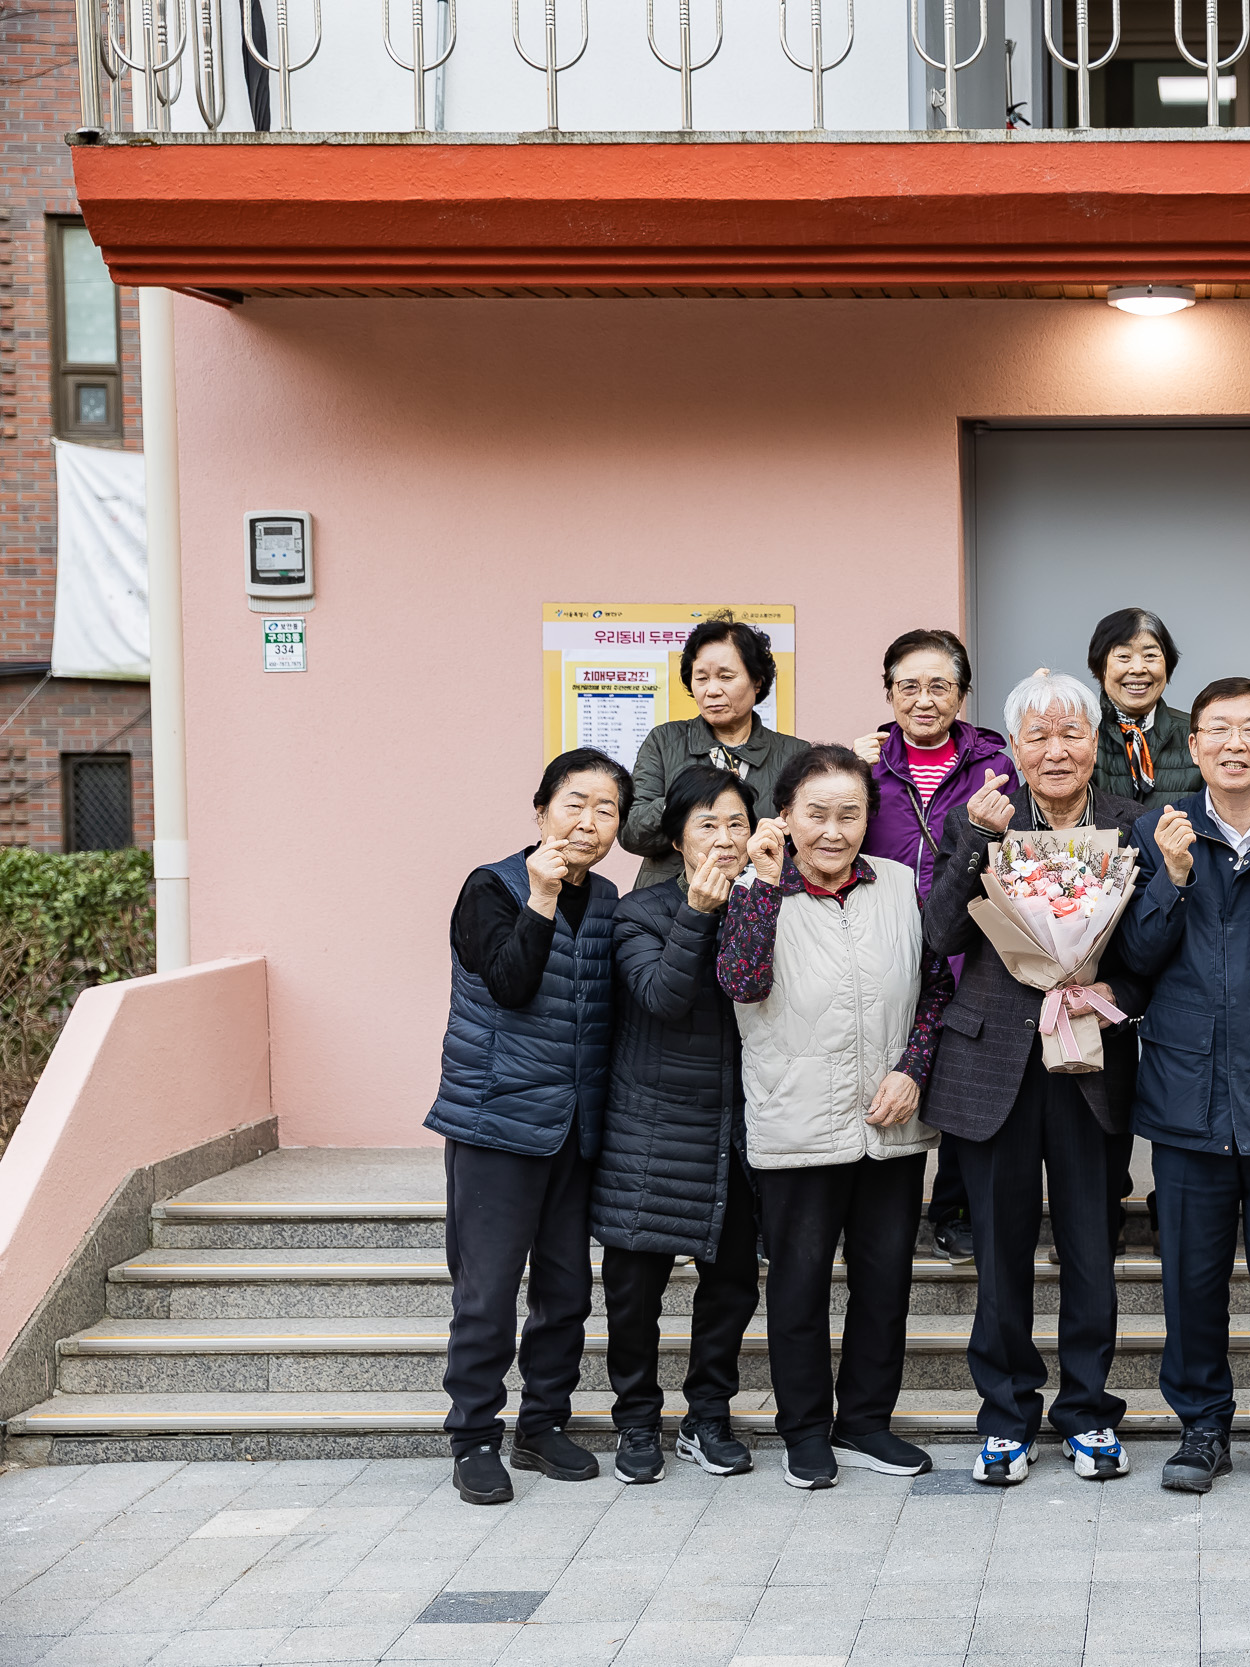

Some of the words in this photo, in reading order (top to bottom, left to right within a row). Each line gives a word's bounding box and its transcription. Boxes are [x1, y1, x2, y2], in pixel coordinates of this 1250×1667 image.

[268, 633, 300, 642] 구의3동
[594, 630, 645, 645] 우리동네
[649, 631, 691, 645] 두루두
[275, 645, 294, 654] 334
[583, 671, 649, 682] 치매무료검진
